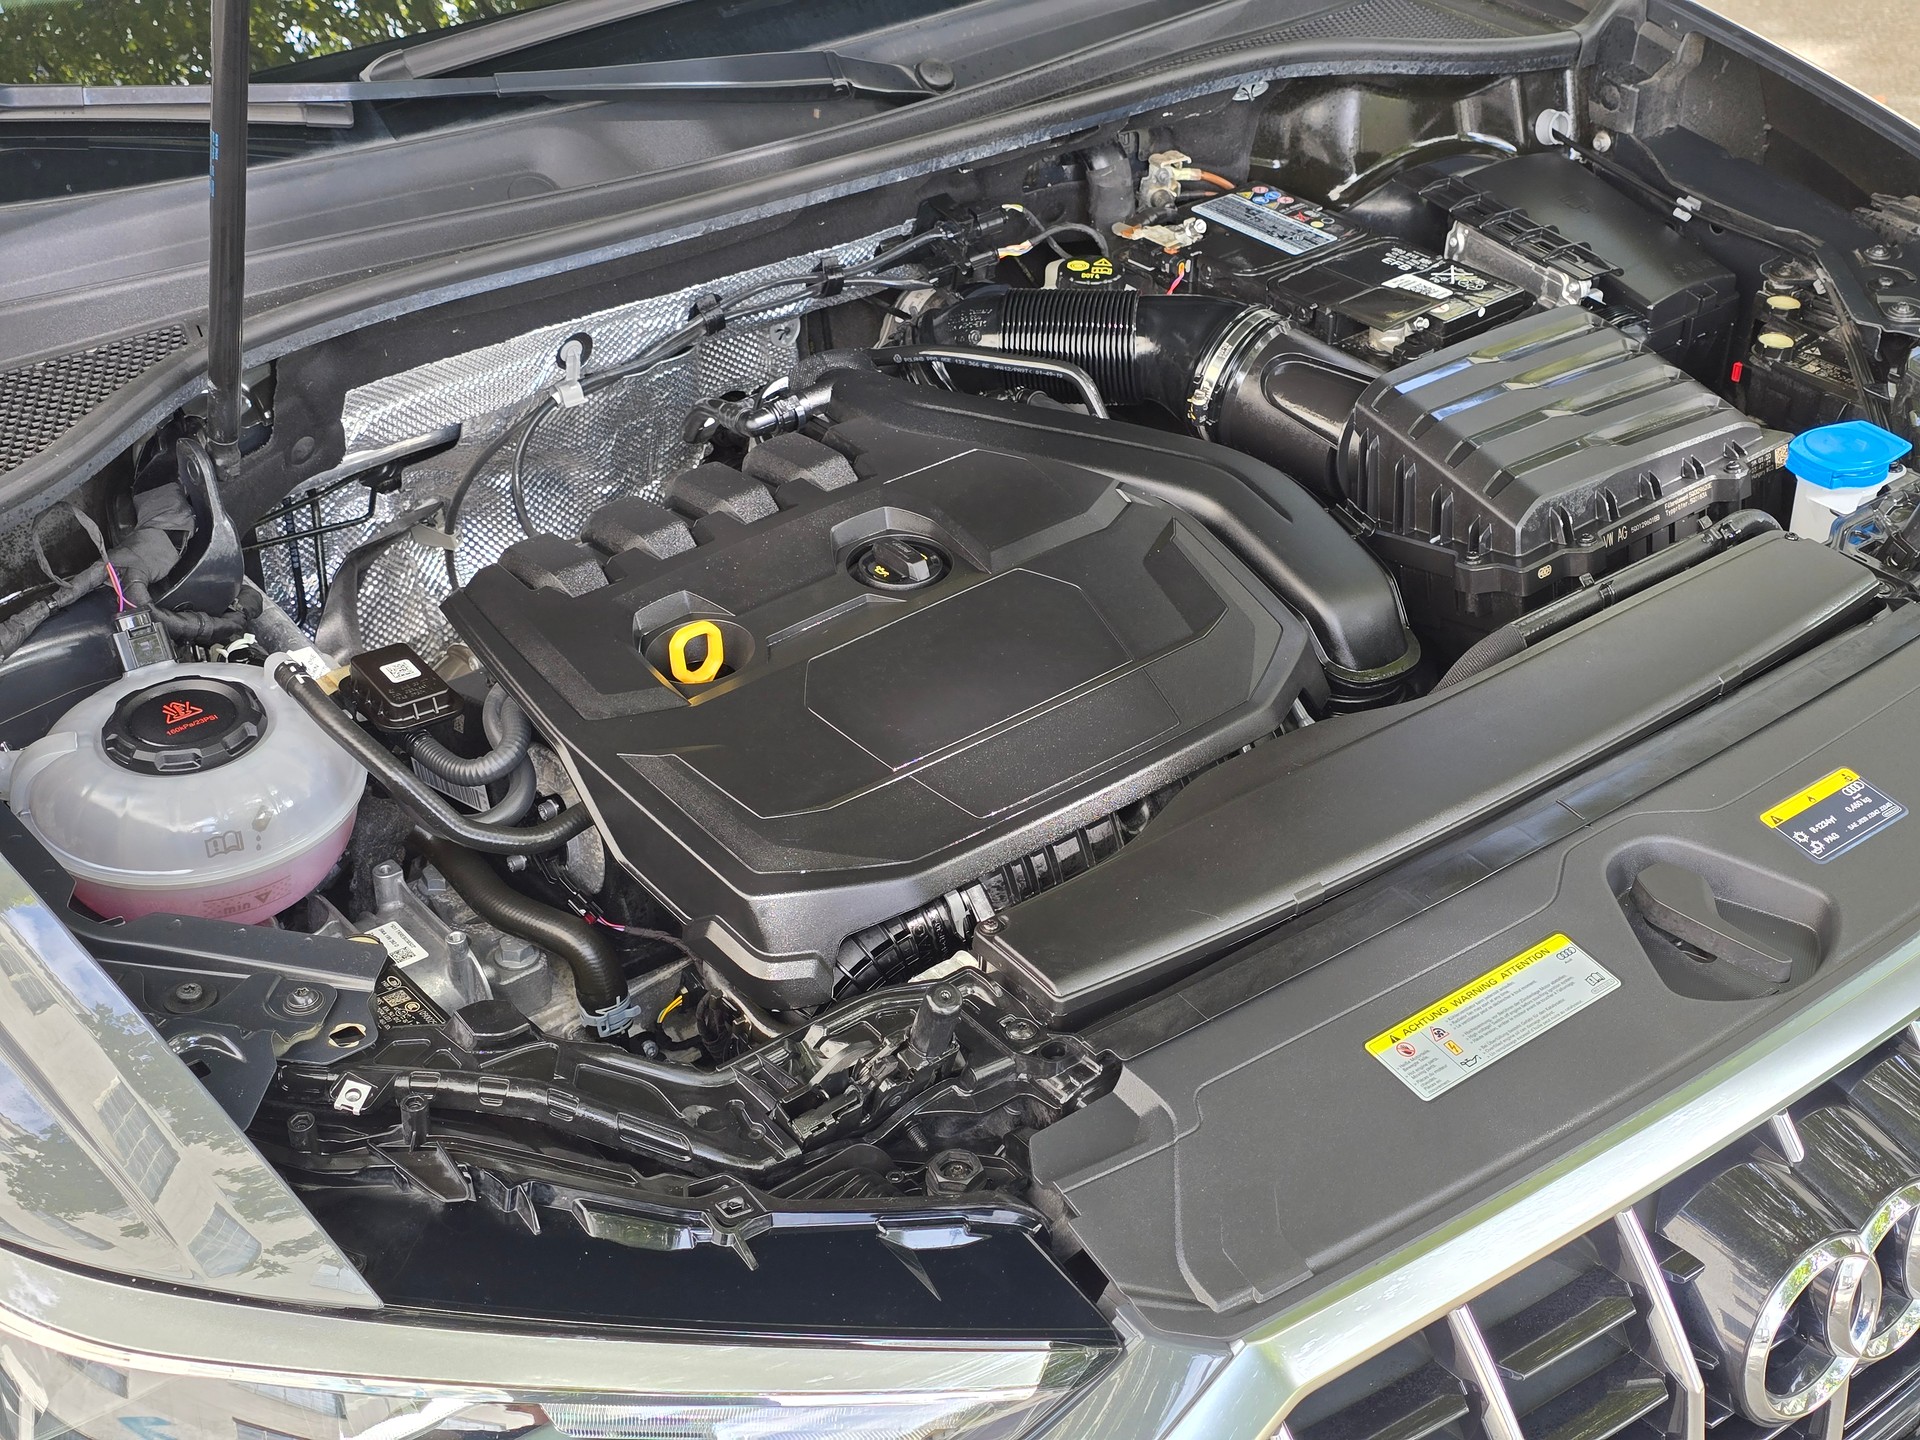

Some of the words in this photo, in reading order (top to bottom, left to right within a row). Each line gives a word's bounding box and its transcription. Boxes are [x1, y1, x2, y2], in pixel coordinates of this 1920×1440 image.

[1382, 258, 1412, 271] EFB
[1603, 532, 1613, 548] VW
[1617, 526, 1628, 542] AG
[166, 714, 218, 736] 160kPa/23PSI
[1823, 832, 1839, 843] PAG
[224, 902, 251, 914] min
[1403, 1006, 1448, 1035] ACHTUNG
[1451, 978, 1497, 1006] WARNING
[1500, 948, 1550, 979] ATTENTION
